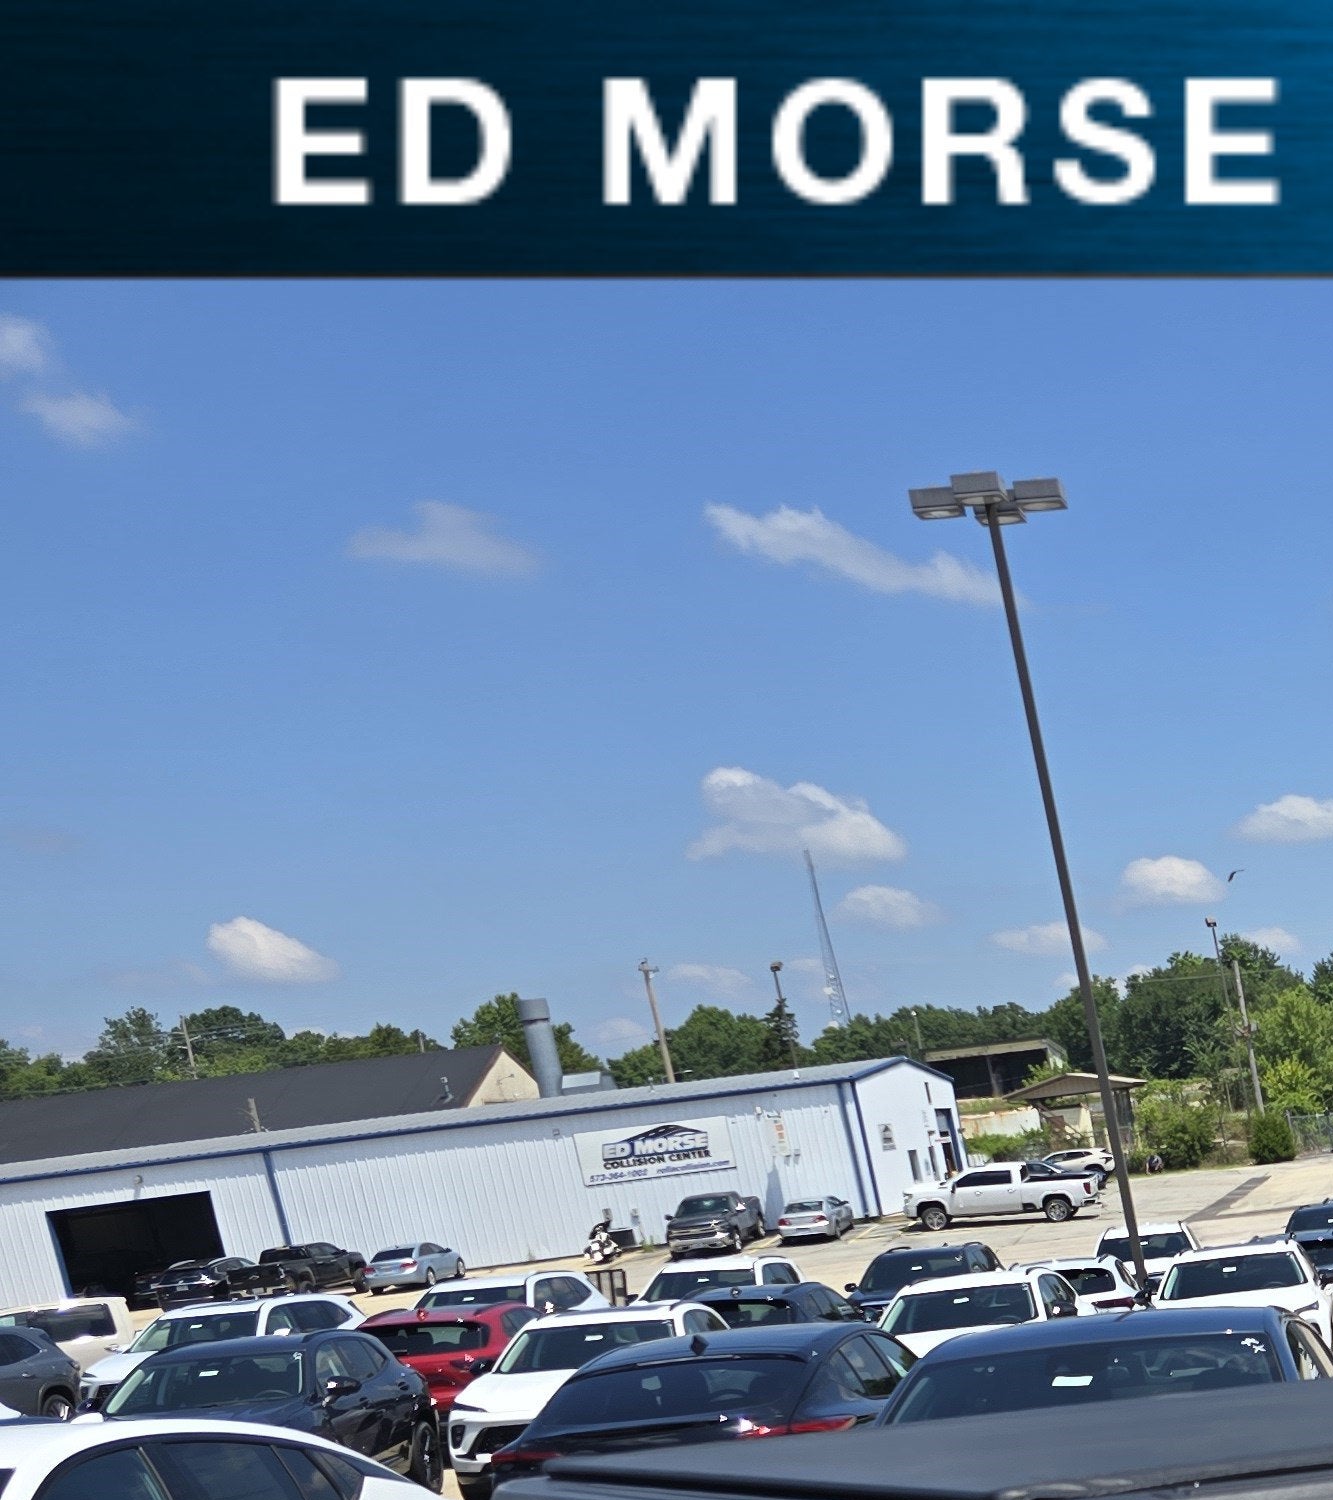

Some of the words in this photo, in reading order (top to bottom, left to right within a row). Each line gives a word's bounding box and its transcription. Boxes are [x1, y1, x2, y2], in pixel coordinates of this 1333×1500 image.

[602, 1141, 632, 1161] ED
[632, 1131, 709, 1157] MORSE
[603, 1156, 665, 1170] COLLISION
[669, 1150, 712, 1163] CENTER
